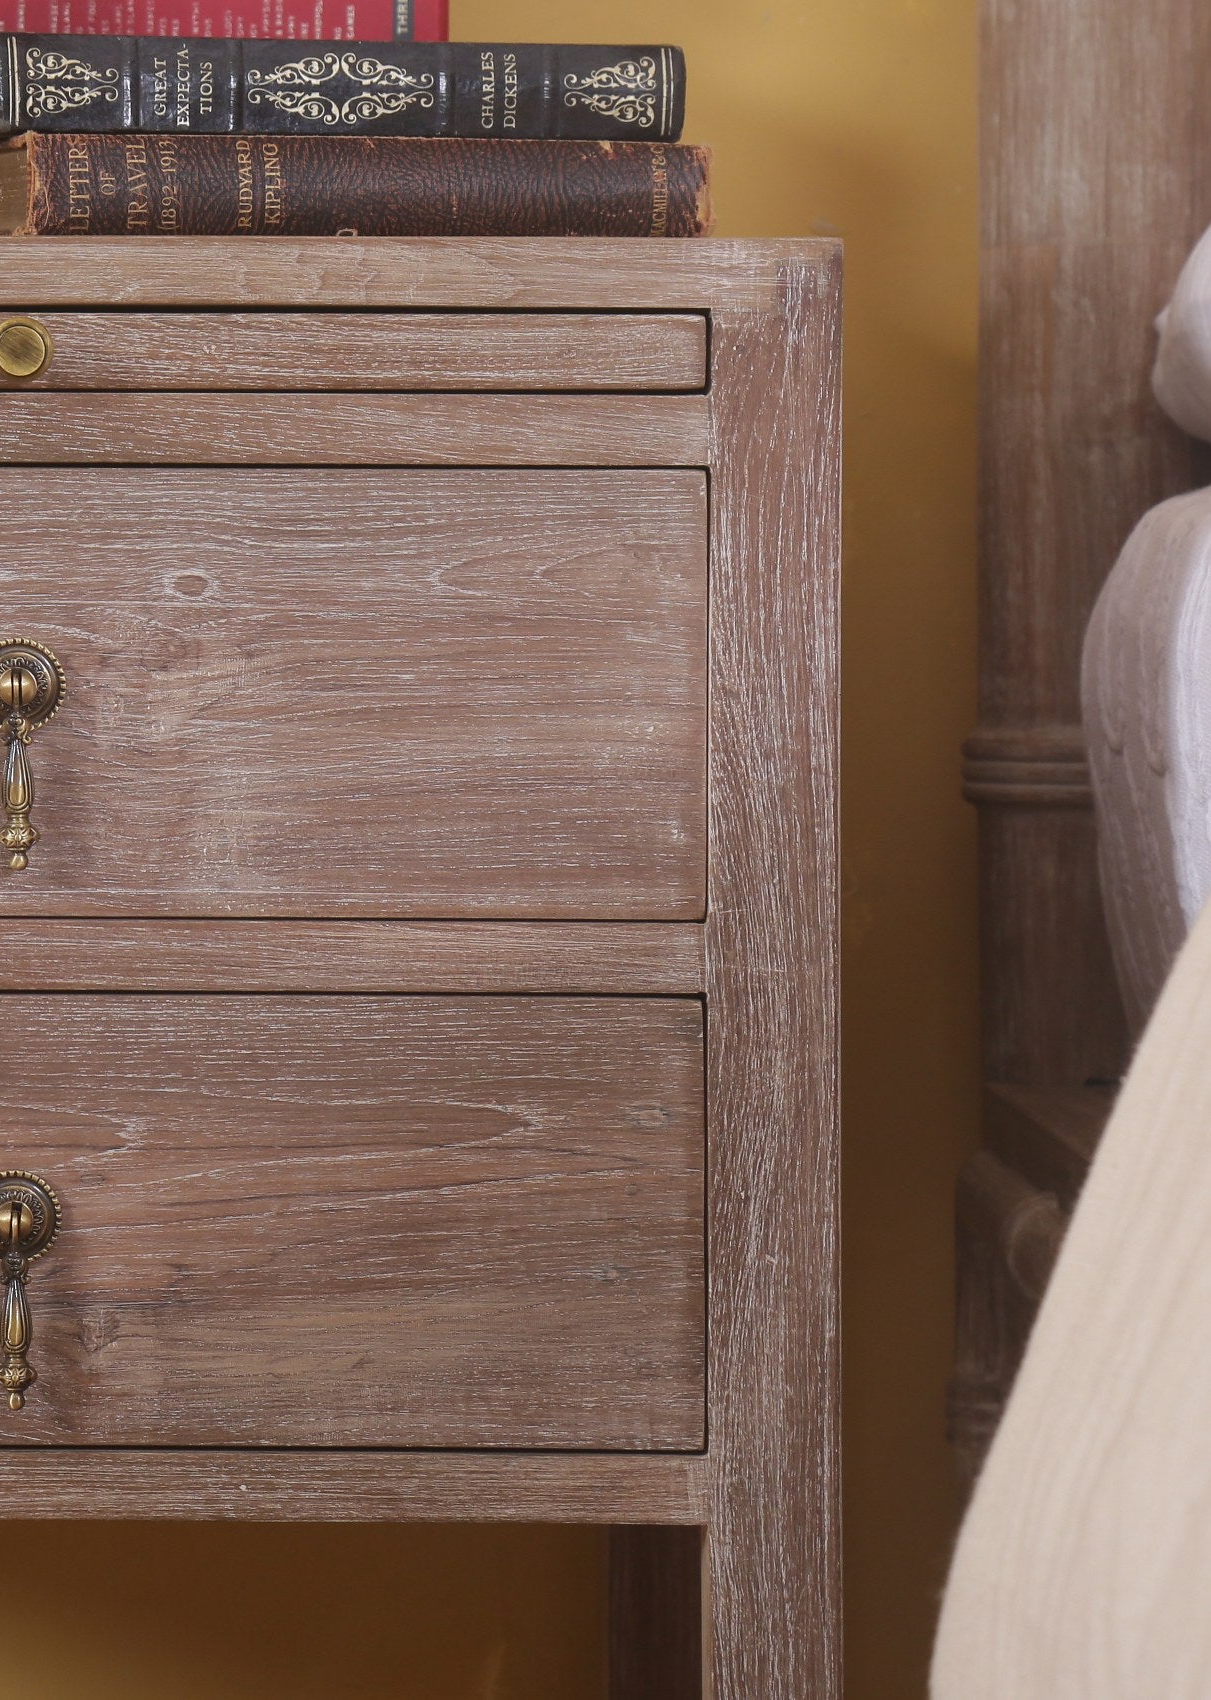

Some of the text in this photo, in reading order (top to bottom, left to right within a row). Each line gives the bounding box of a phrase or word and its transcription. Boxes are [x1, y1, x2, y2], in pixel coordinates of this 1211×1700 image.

[154, 58, 167, 116] GREAT
[176, 43, 190, 127] EXPECTA-
[199, 61, 213, 114] TIONS
[481, 51, 494, 129] CHARLES
[503, 53, 516, 129] DICKENS
[100, 171, 116, 196] OF
[126, 137, 148, 230] TRAVEL
[235, 139, 253, 228] RUDYARD
[262, 142, 281, 224] KIPLING
